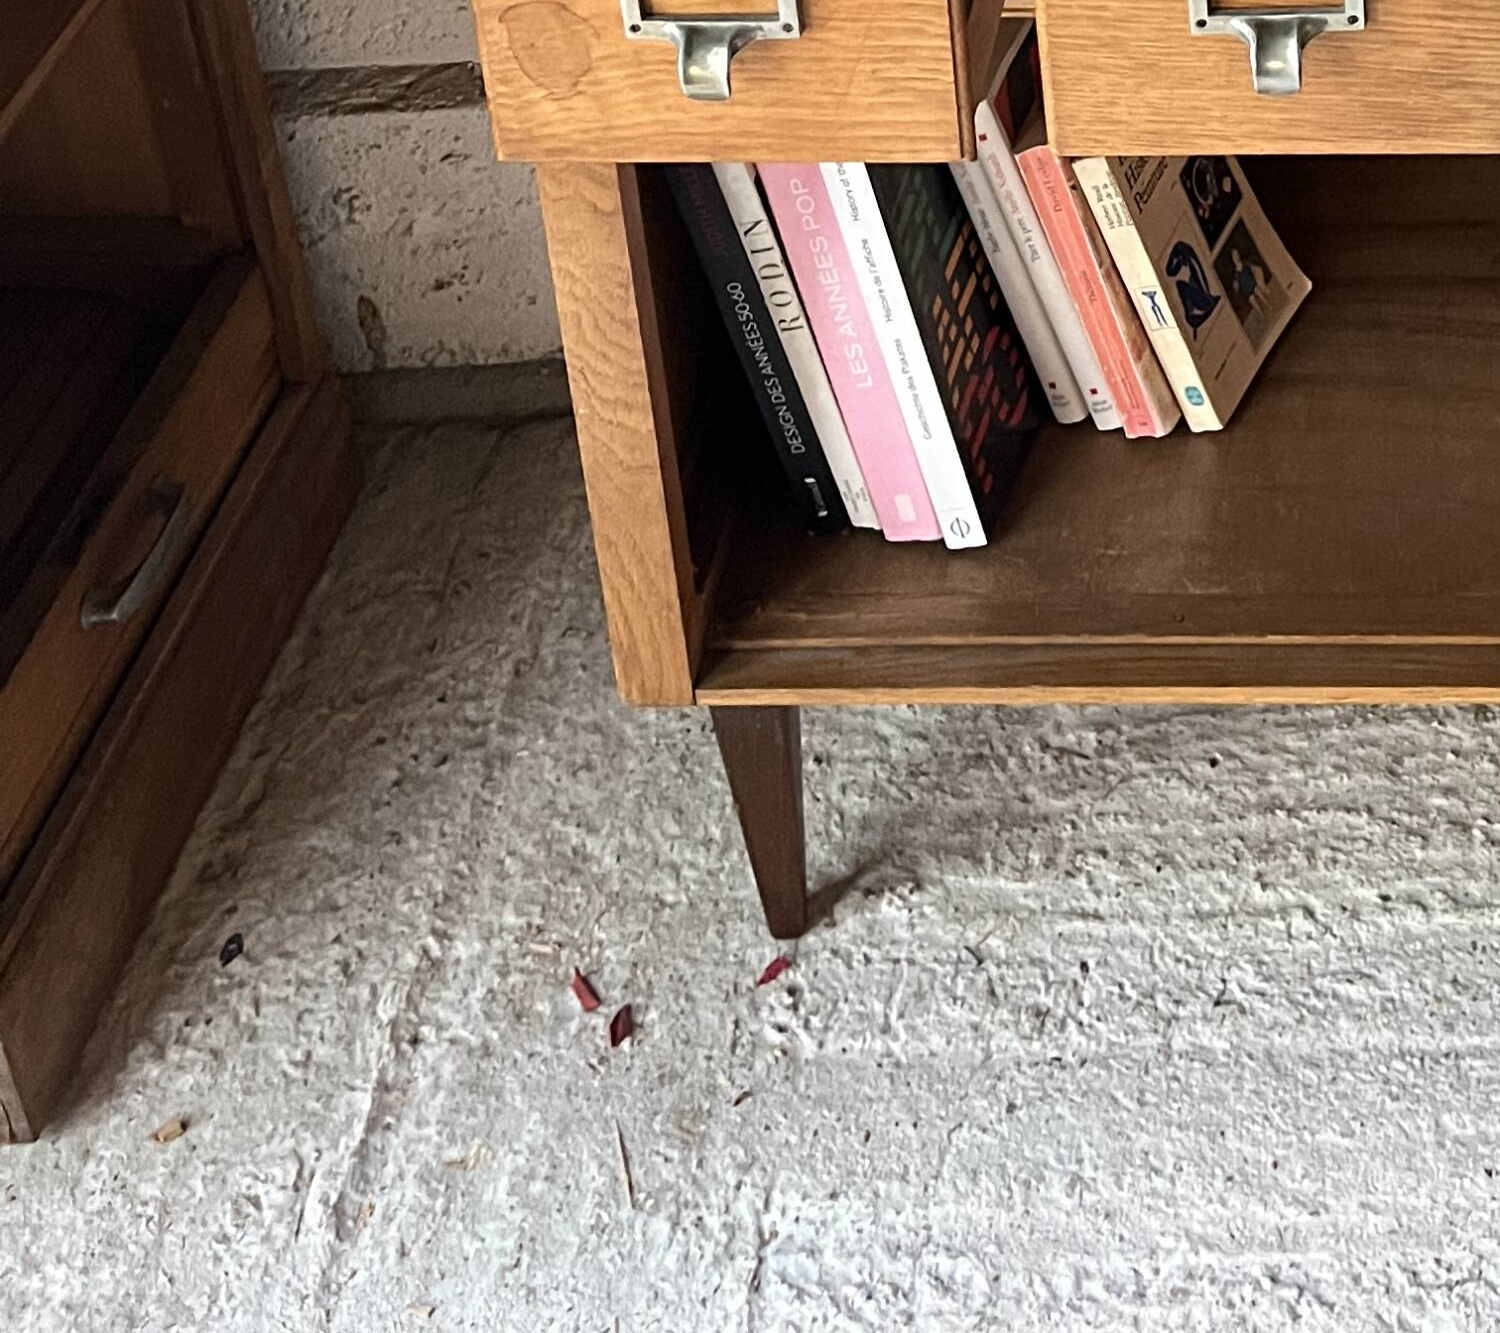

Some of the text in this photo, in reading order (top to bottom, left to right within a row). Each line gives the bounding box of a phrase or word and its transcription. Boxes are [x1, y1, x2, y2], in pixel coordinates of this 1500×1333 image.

[743, 218, 804, 334] RODIN
[788, 175, 874, 389] LES ANNÉES POP
[726, 280, 806, 454] DESIGN DES ANNÉES 50-60
